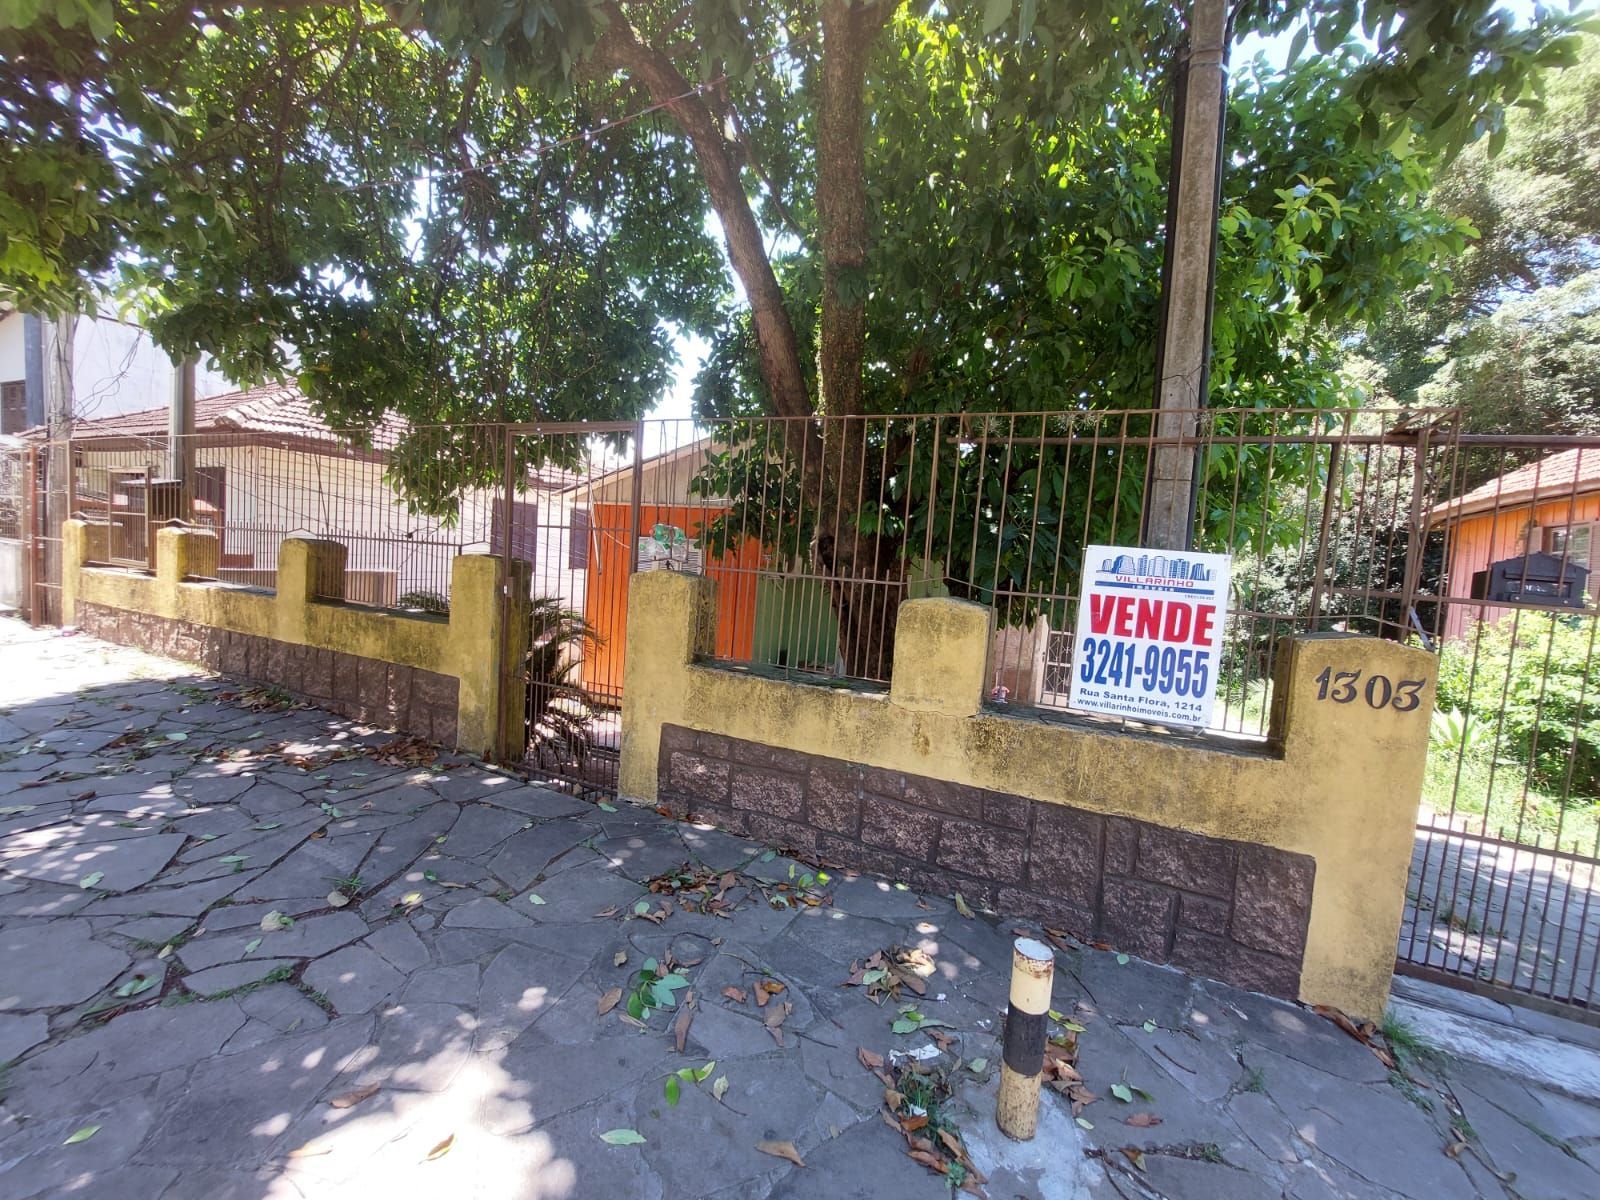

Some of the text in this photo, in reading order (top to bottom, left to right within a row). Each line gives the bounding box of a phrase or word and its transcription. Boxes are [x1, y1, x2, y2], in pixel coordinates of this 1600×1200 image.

[1115, 575, 1194, 588] VILLARINHO
[1090, 593, 1216, 647] VENDE
[1080, 637, 1210, 699] 3241-9955
[1080, 687, 1202, 712] Rua Santa Flora, 1214
[1315, 666, 1426, 712] 1303
[1077, 698, 1201, 722] www.villarinhoimoveis.com.br
